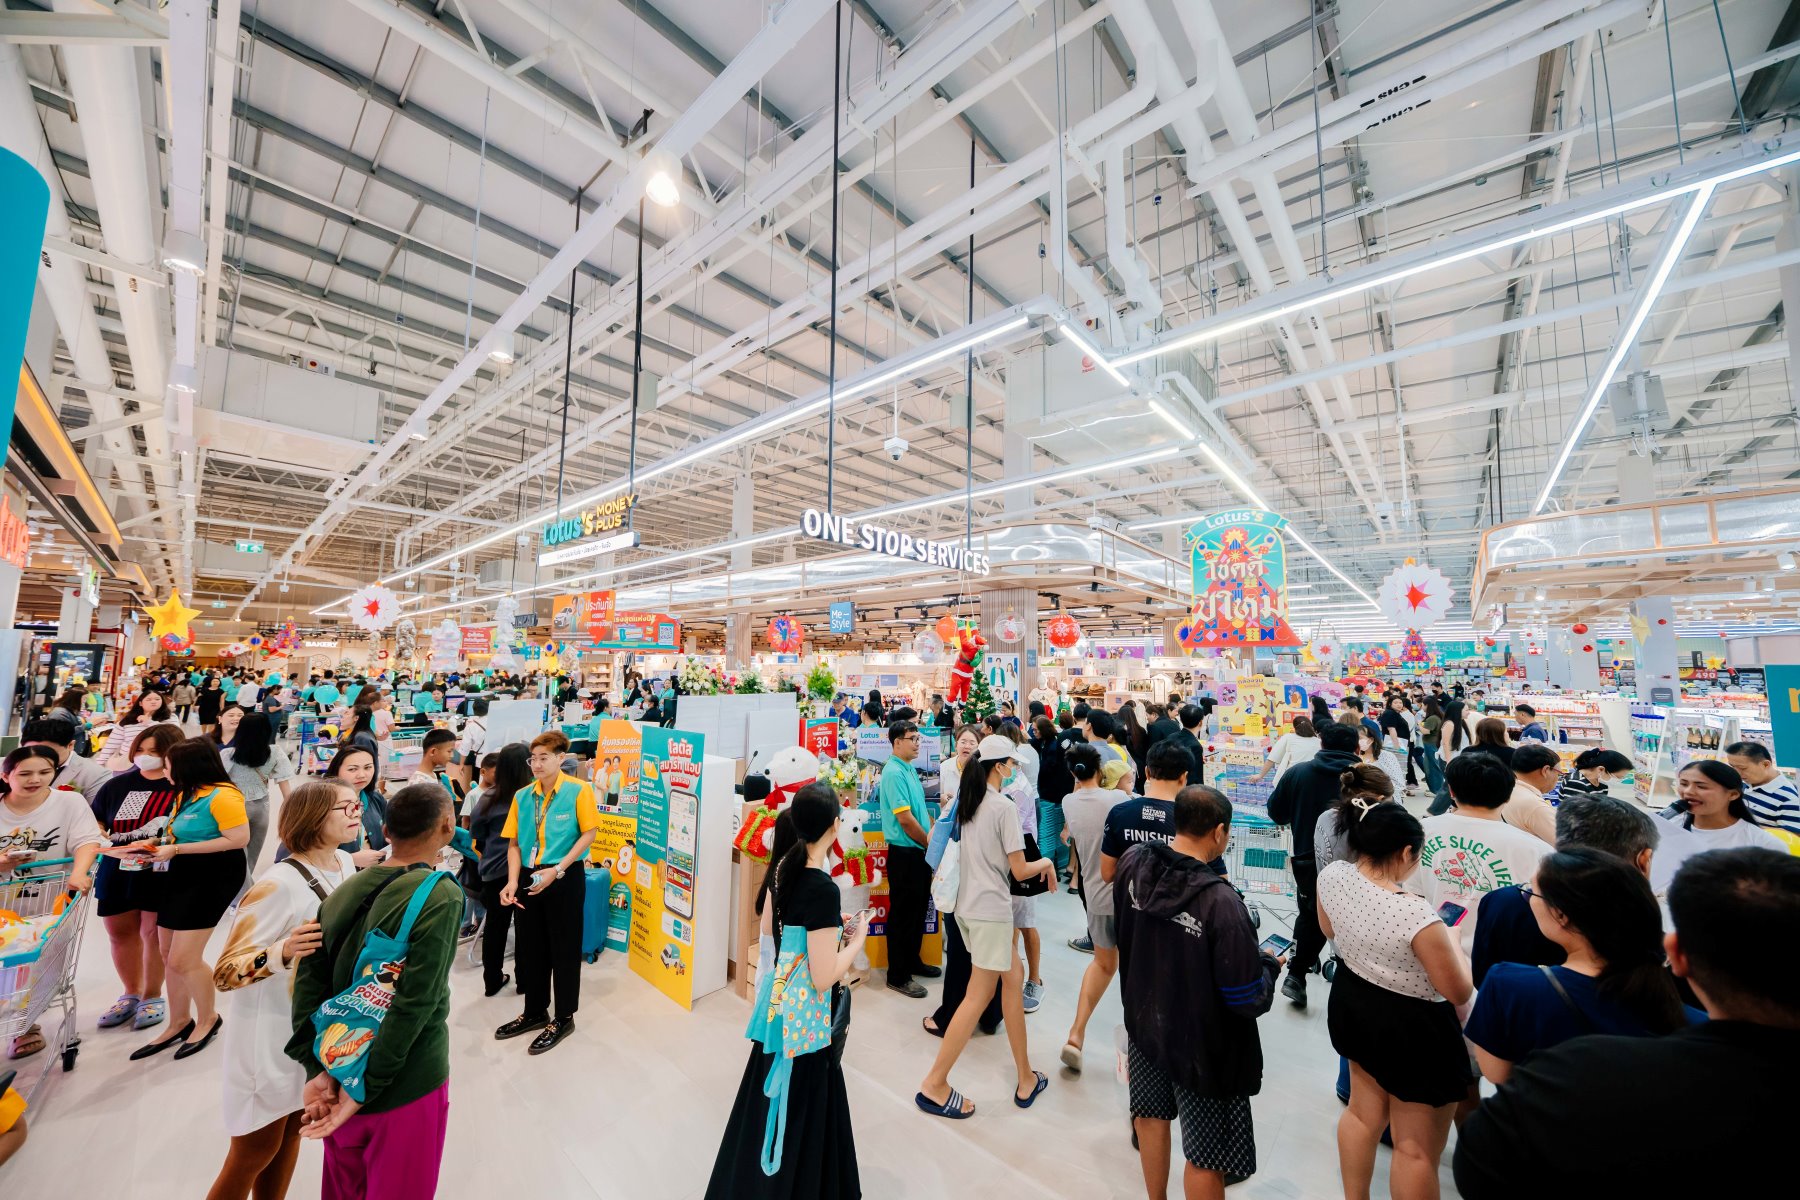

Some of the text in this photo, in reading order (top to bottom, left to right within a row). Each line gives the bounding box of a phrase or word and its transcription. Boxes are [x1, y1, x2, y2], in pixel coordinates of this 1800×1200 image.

[543, 494, 634, 546] Lotus's MONEY
[596, 514, 622, 532] PLUS
[1205, 510, 1264, 529] Lotus's
[803, 508, 990, 576] ONE STOP SERVICES
[585, 597, 613, 611] ประกันภัย
[831, 619, 850, 629] Style
[668, 738, 693, 756] โลตัส
[618, 846, 633, 875] 8
[1421, 836, 1446, 868] THREE
[1450, 836, 1494, 860] SLICE
